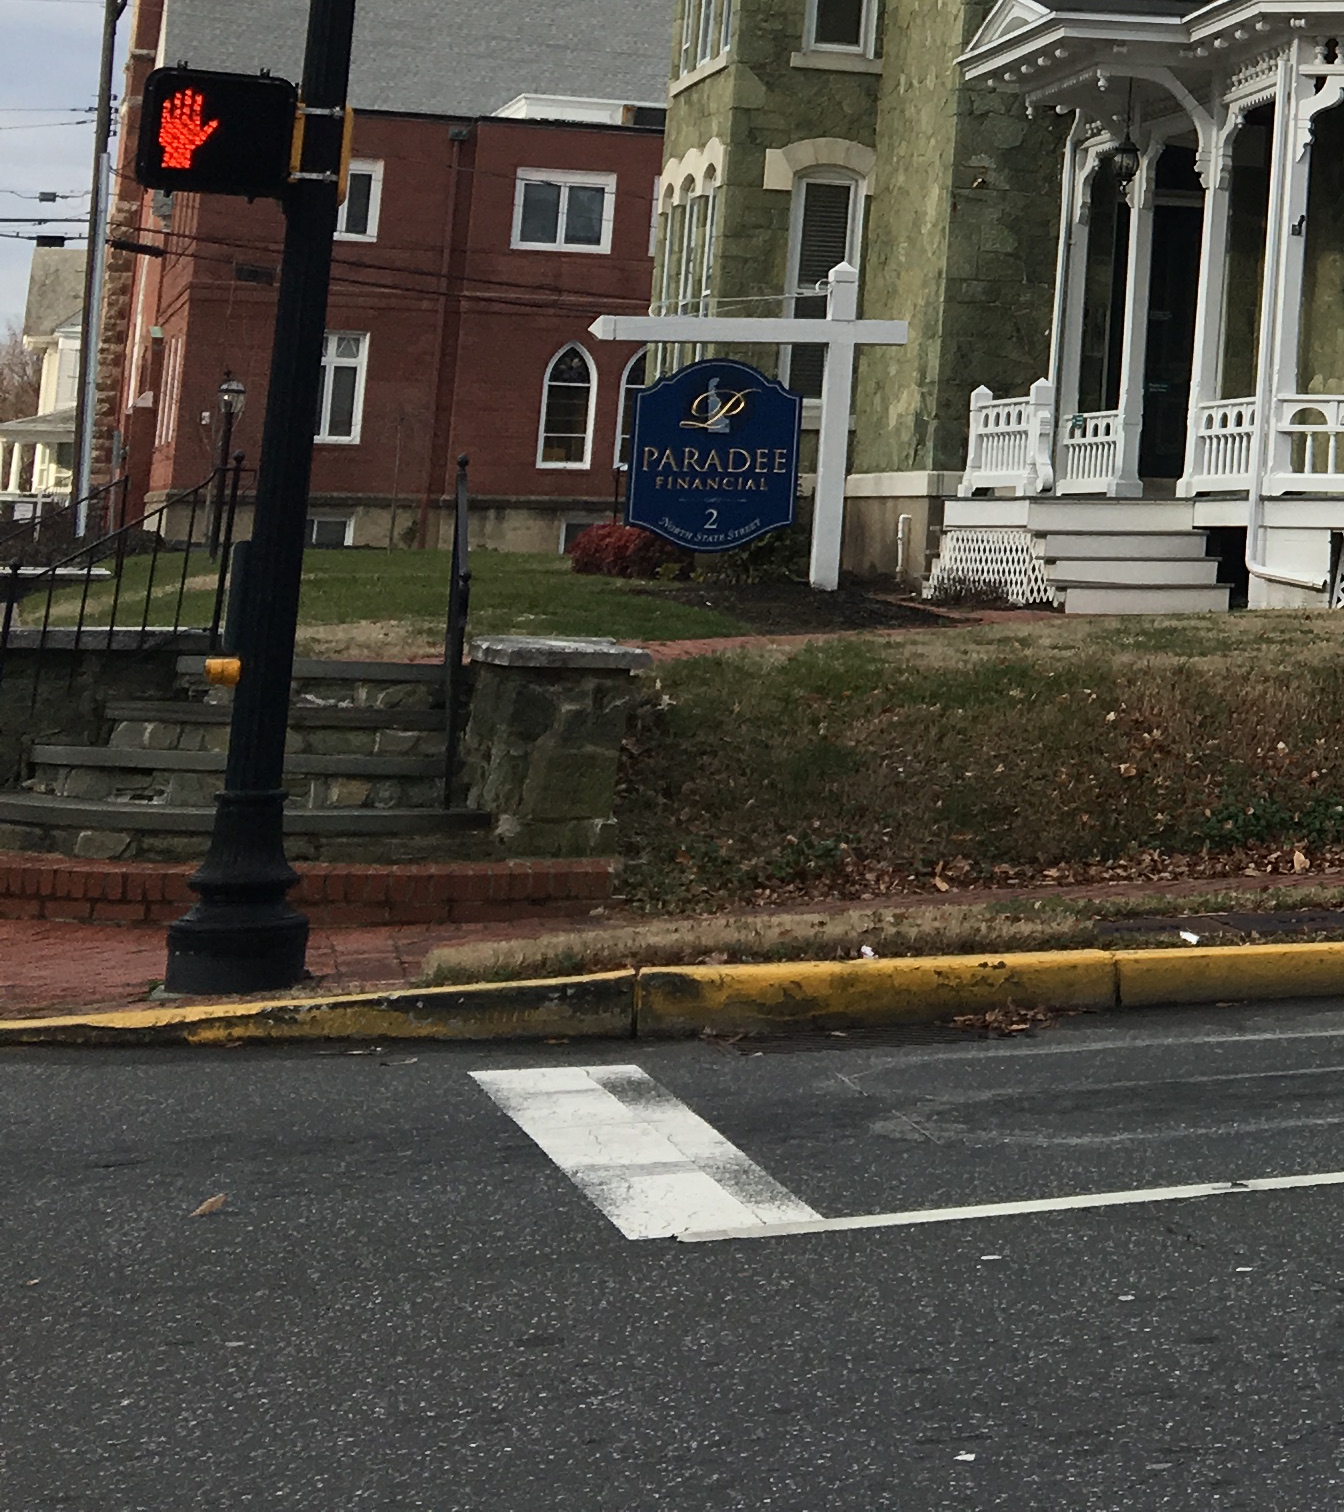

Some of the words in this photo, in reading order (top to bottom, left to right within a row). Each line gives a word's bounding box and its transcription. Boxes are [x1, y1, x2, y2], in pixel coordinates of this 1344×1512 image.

[642, 446, 787, 473] PARADEE
[655, 475, 768, 491] FINANCIAL
[703, 508, 718, 529] 2
